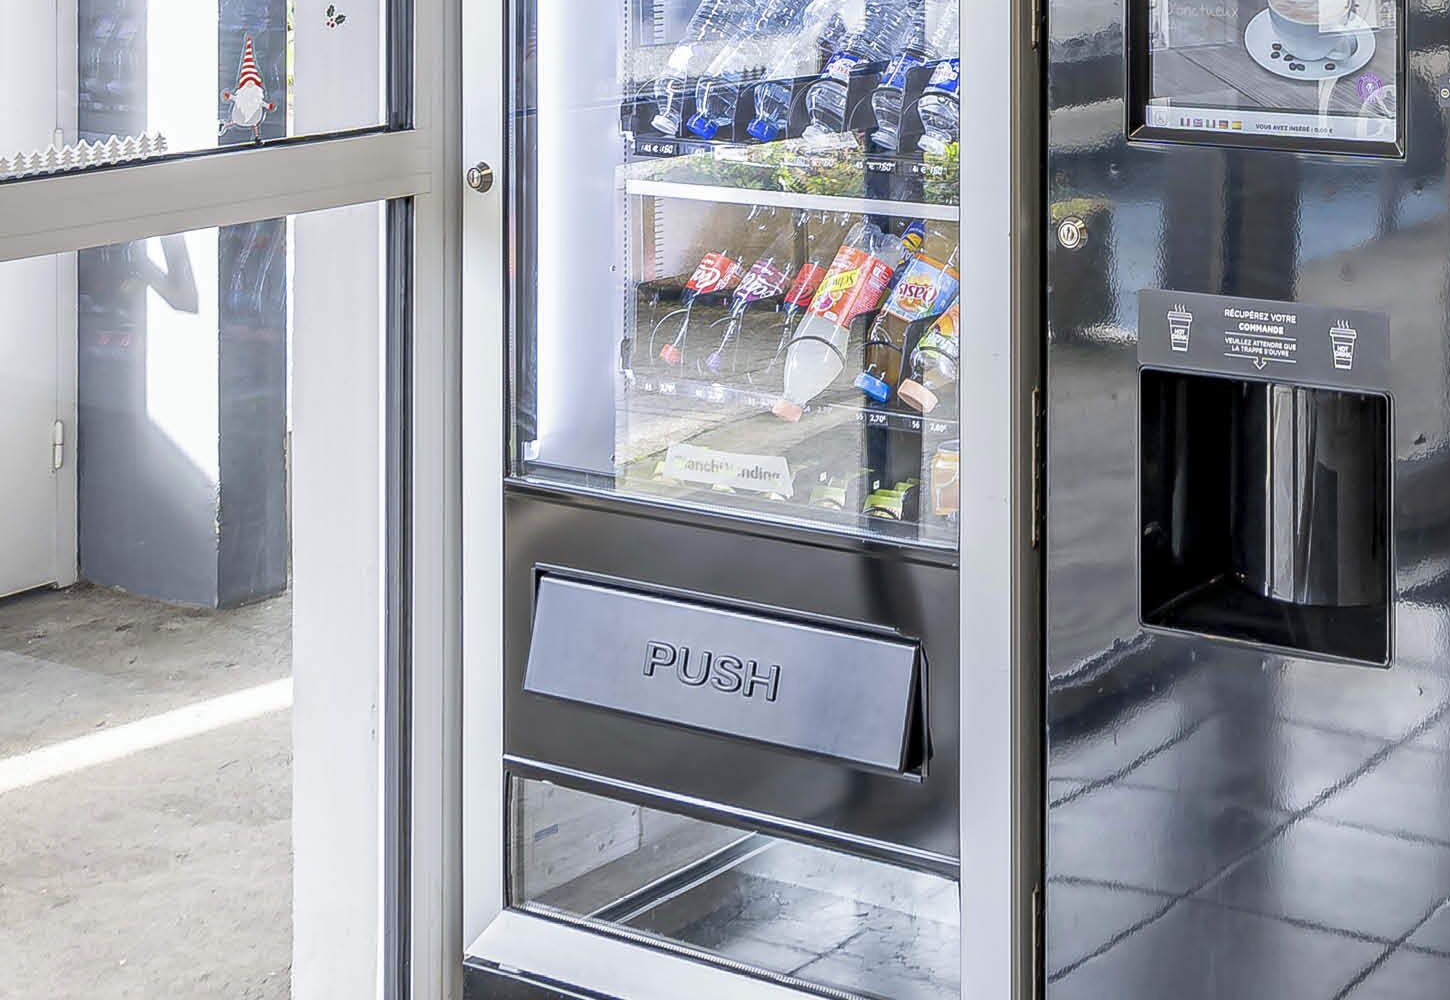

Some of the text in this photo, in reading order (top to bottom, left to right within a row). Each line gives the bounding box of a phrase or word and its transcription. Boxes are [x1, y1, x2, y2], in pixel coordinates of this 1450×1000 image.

[1224, 308, 1297, 324] RÉCUPÉREZ VOTRE
[1238, 322, 1284, 335] COMMANDE
[1224, 337, 1252, 345] VEUILLEZ
[1252, 340, 1283, 349] ATTENDRE
[1240, 346, 1263, 354] TRAPPE
[643, 640, 782, 702] PUSH
